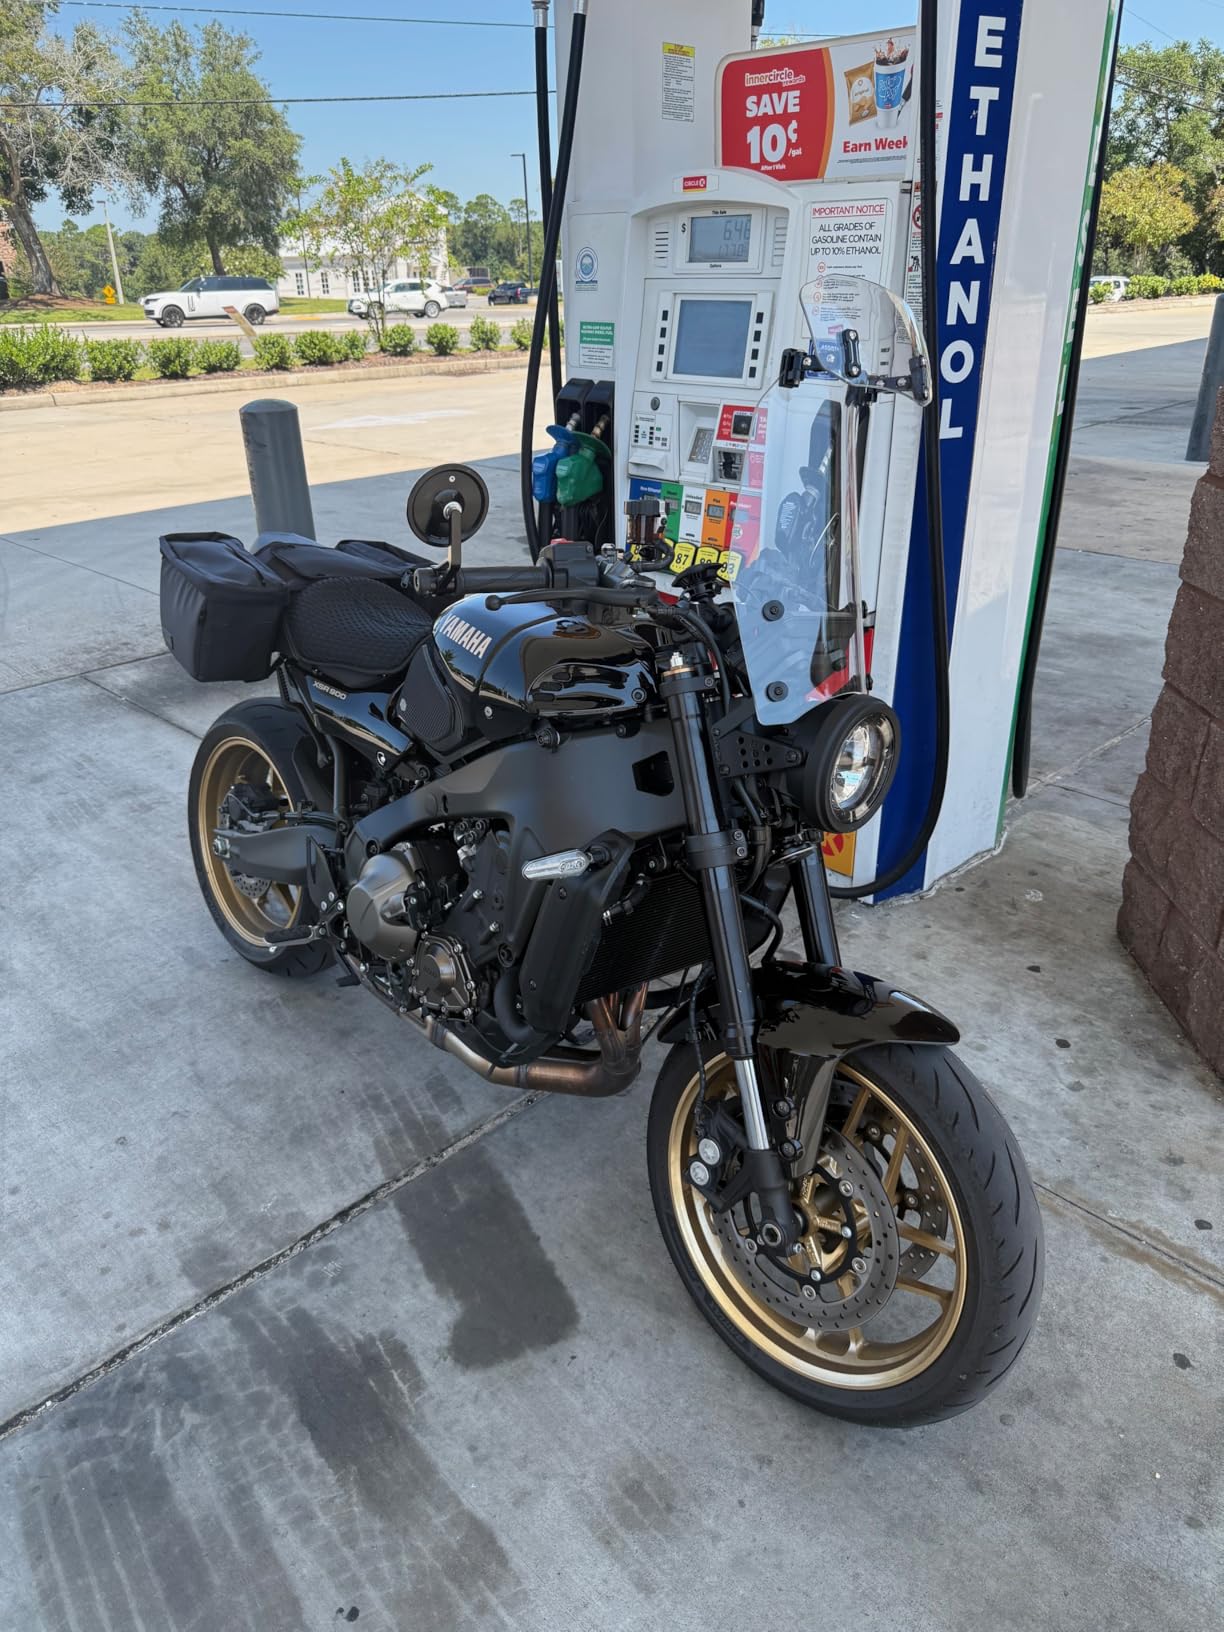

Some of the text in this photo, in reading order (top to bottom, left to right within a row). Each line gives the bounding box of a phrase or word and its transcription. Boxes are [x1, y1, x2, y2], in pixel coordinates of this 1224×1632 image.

[745, 68, 793, 86] innercircle
[746, 90, 800, 117] SAVE
[843, 141, 872, 153] Earn
[813, 204, 885, 216] IMPORTANT NOTICE
[819, 221, 876, 232] ALL GRADES OF
[938, 15, 1006, 440] ETHANOL
[812, 234, 882, 244] GASOLINE CONTAIN
[811, 246, 881, 256] UP TO 10% ETHANOL
[675, 553, 689, 565] 87
[440, 613, 492, 659] YAMAHA
